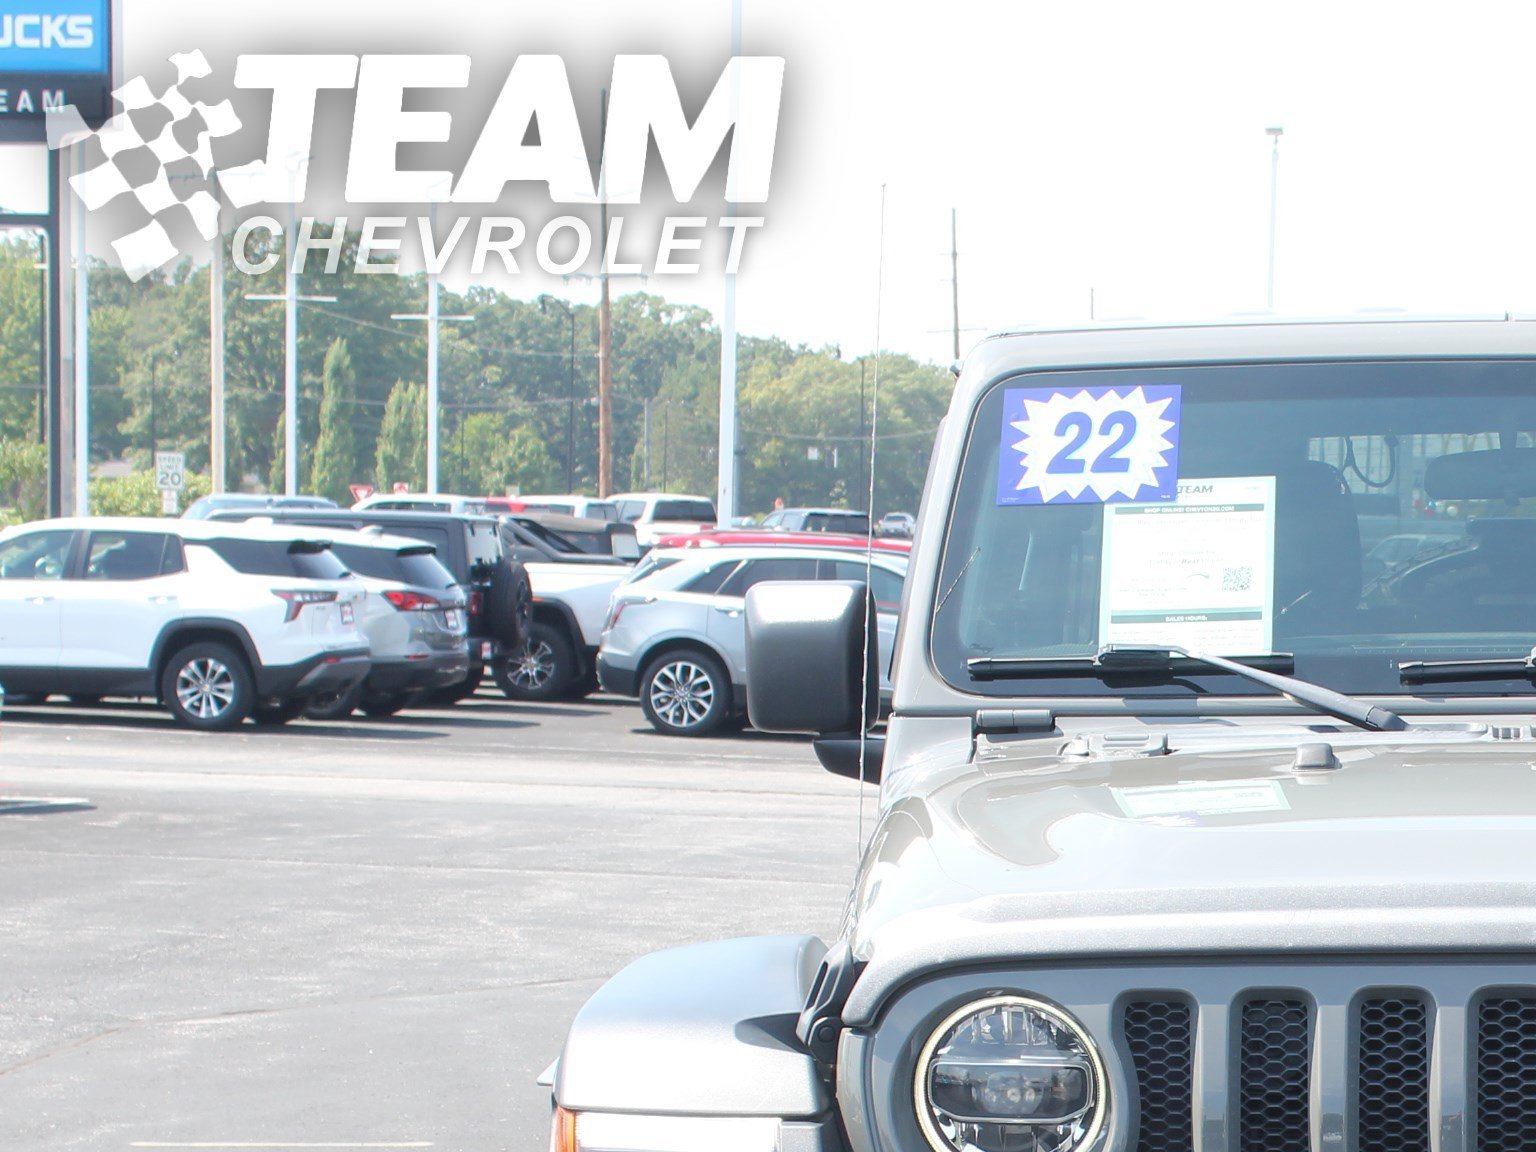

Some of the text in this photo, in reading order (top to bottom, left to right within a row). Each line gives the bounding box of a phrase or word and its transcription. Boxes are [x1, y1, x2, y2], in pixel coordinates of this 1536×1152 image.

[1045, 409, 1137, 475] 22
[159, 472, 181, 486] 20
[1176, 485, 1214, 494] TEAM
